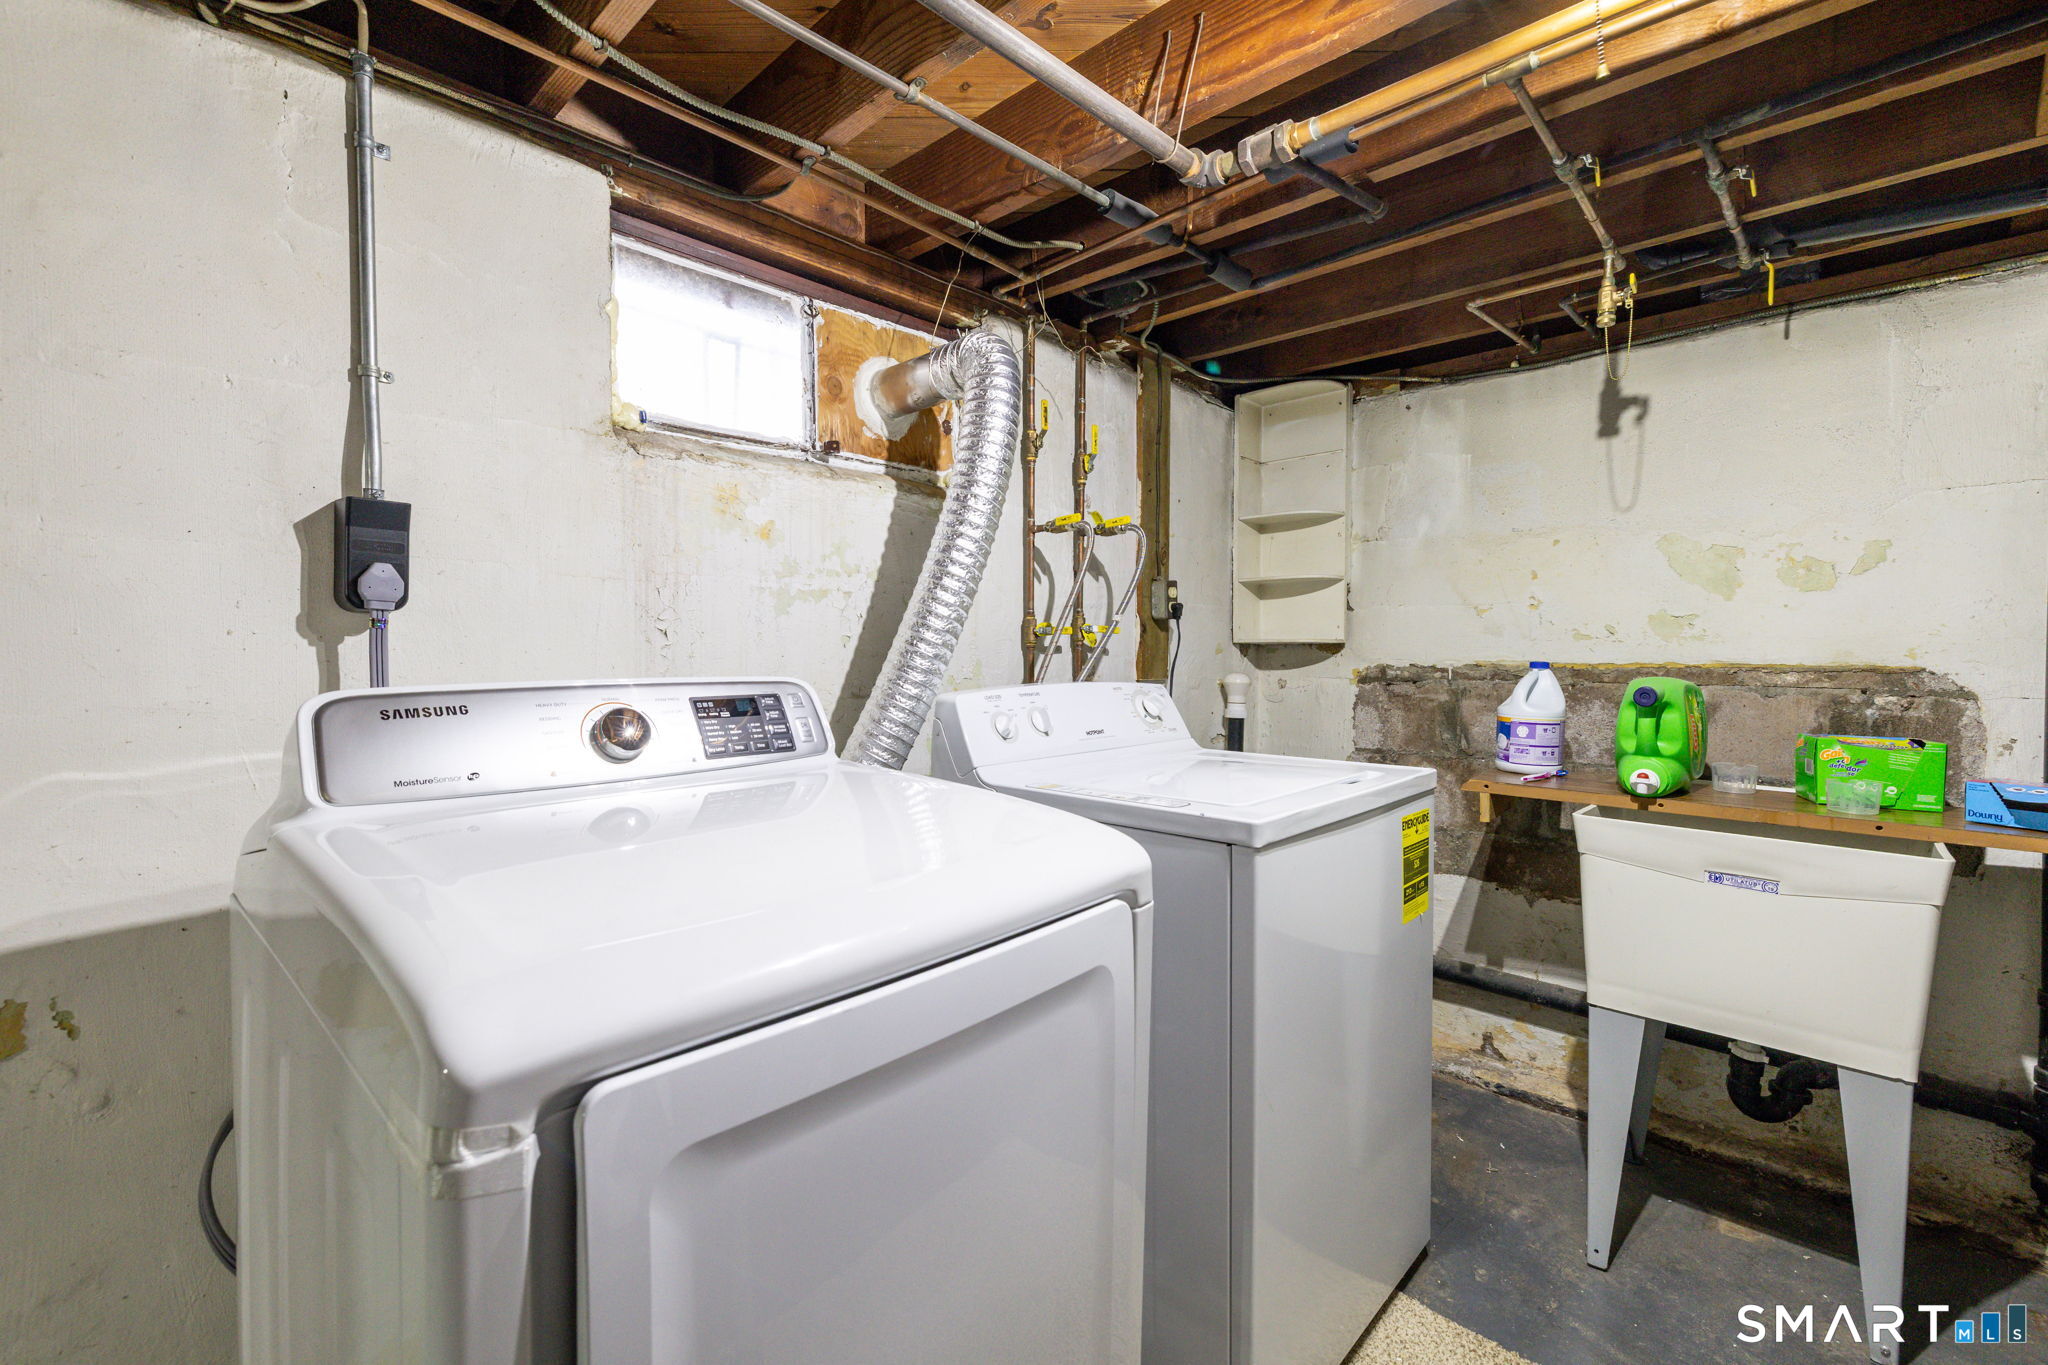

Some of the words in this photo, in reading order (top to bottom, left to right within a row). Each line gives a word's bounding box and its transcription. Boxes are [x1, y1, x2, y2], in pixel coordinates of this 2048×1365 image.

[380, 704, 469, 721] SAMSUNG
[393, 775, 461, 788] MoistureSensor
[1968, 809, 2003, 823] Downy
